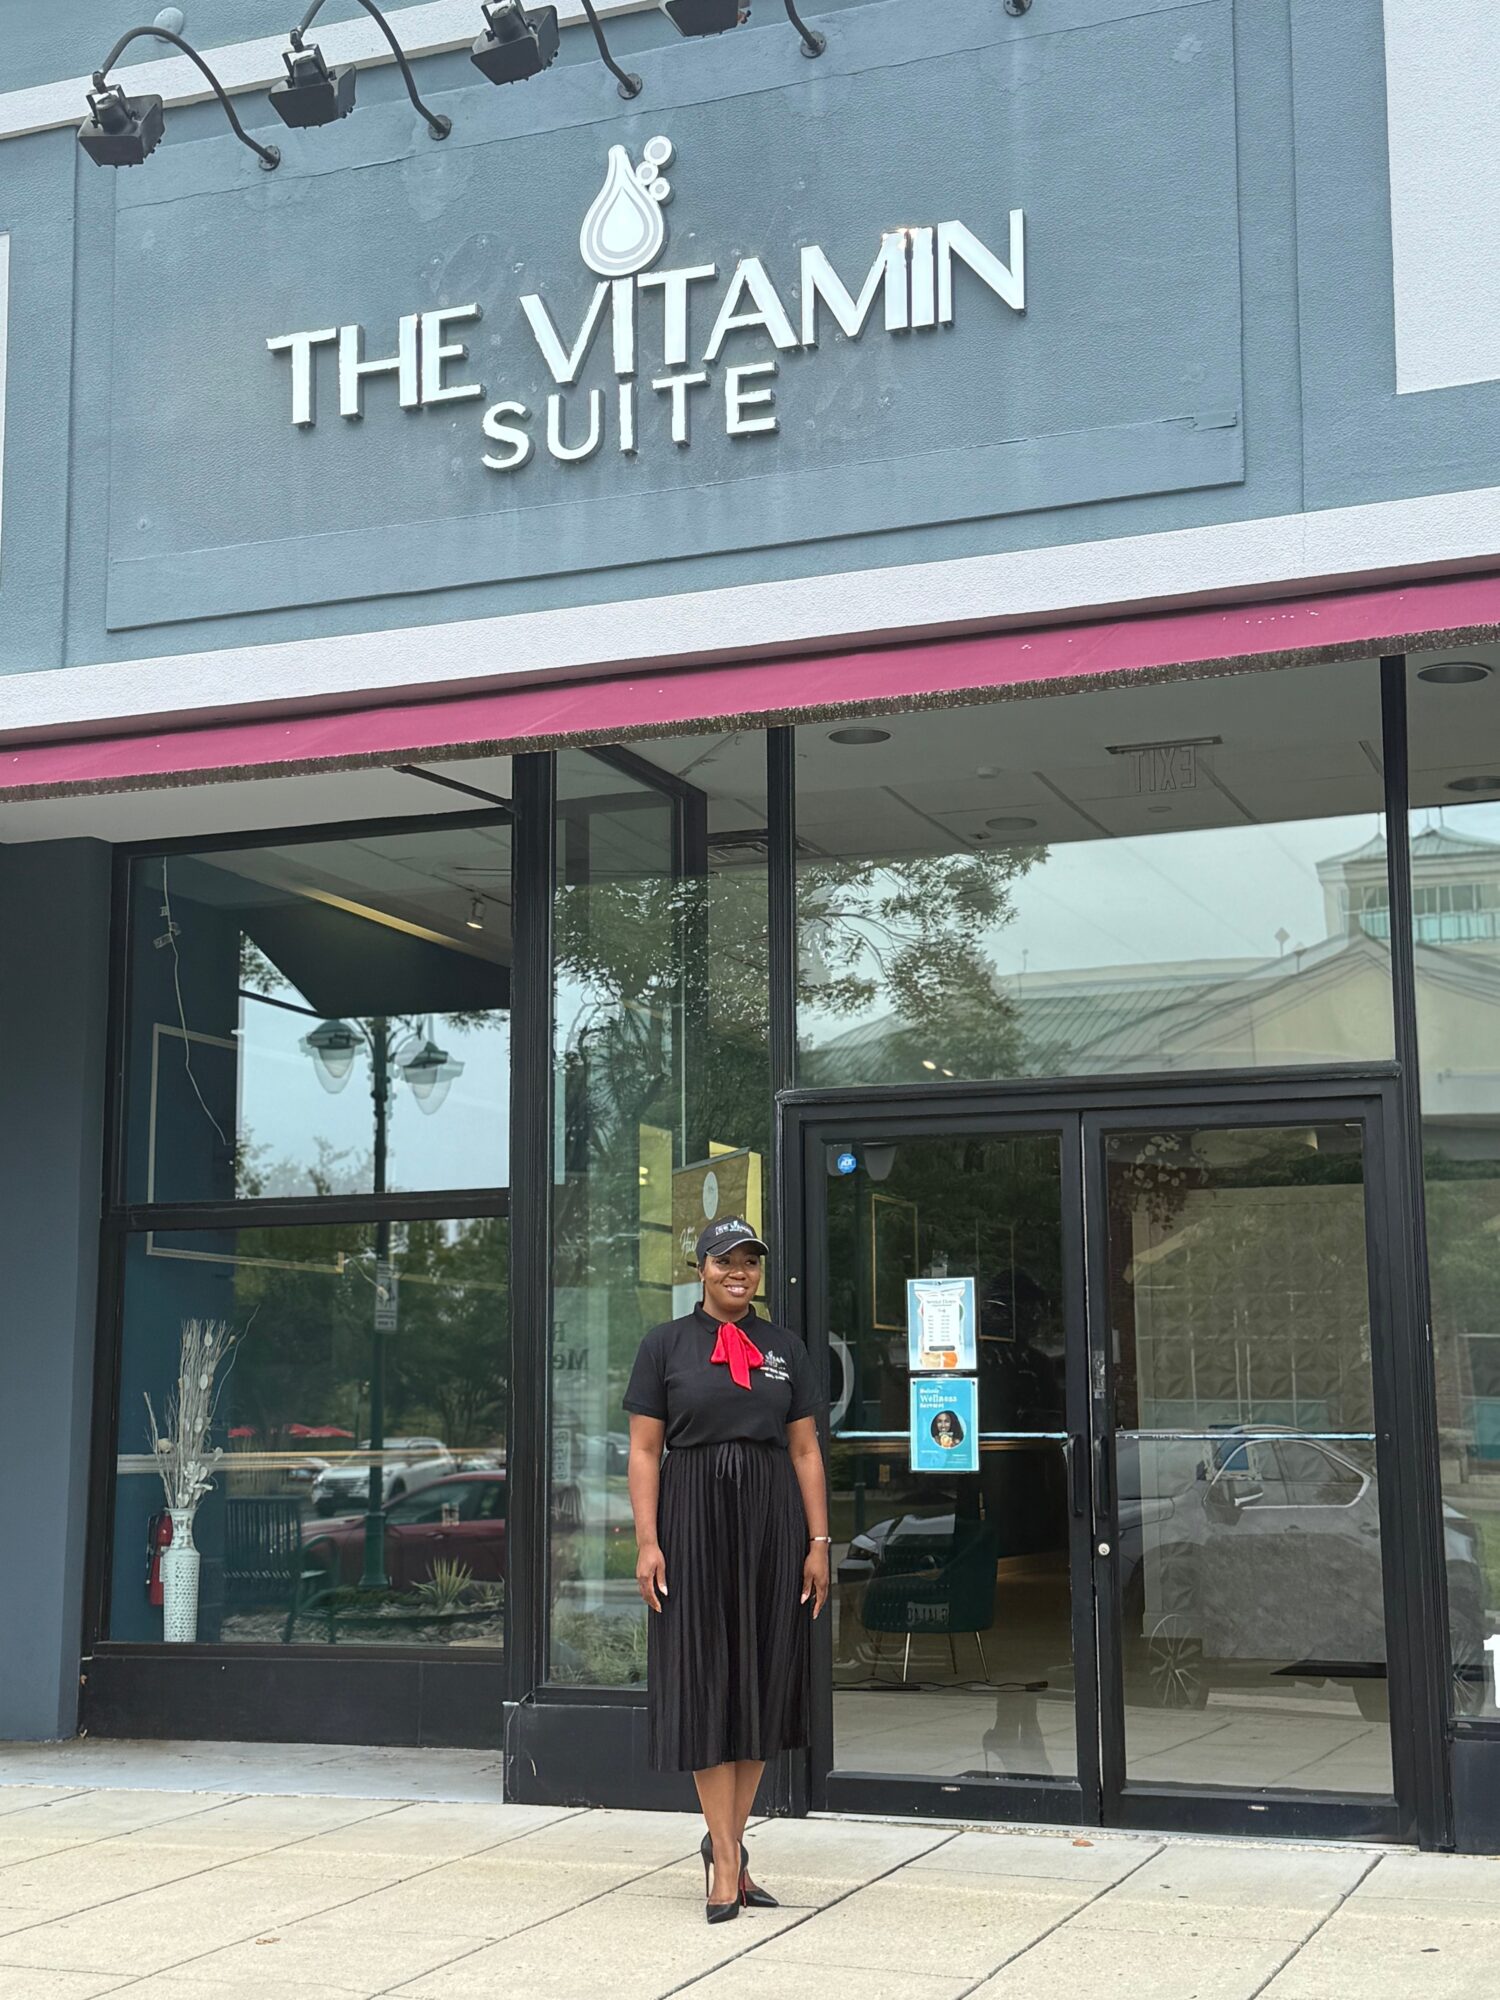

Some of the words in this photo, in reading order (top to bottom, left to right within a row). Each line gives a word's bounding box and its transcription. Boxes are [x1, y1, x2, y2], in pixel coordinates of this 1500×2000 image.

[266, 302, 486, 428] THE
[519, 207, 1027, 385] VITAMIN
[480, 360, 781, 472] SUITE
[919, 1394, 957, 1402] Wellness
